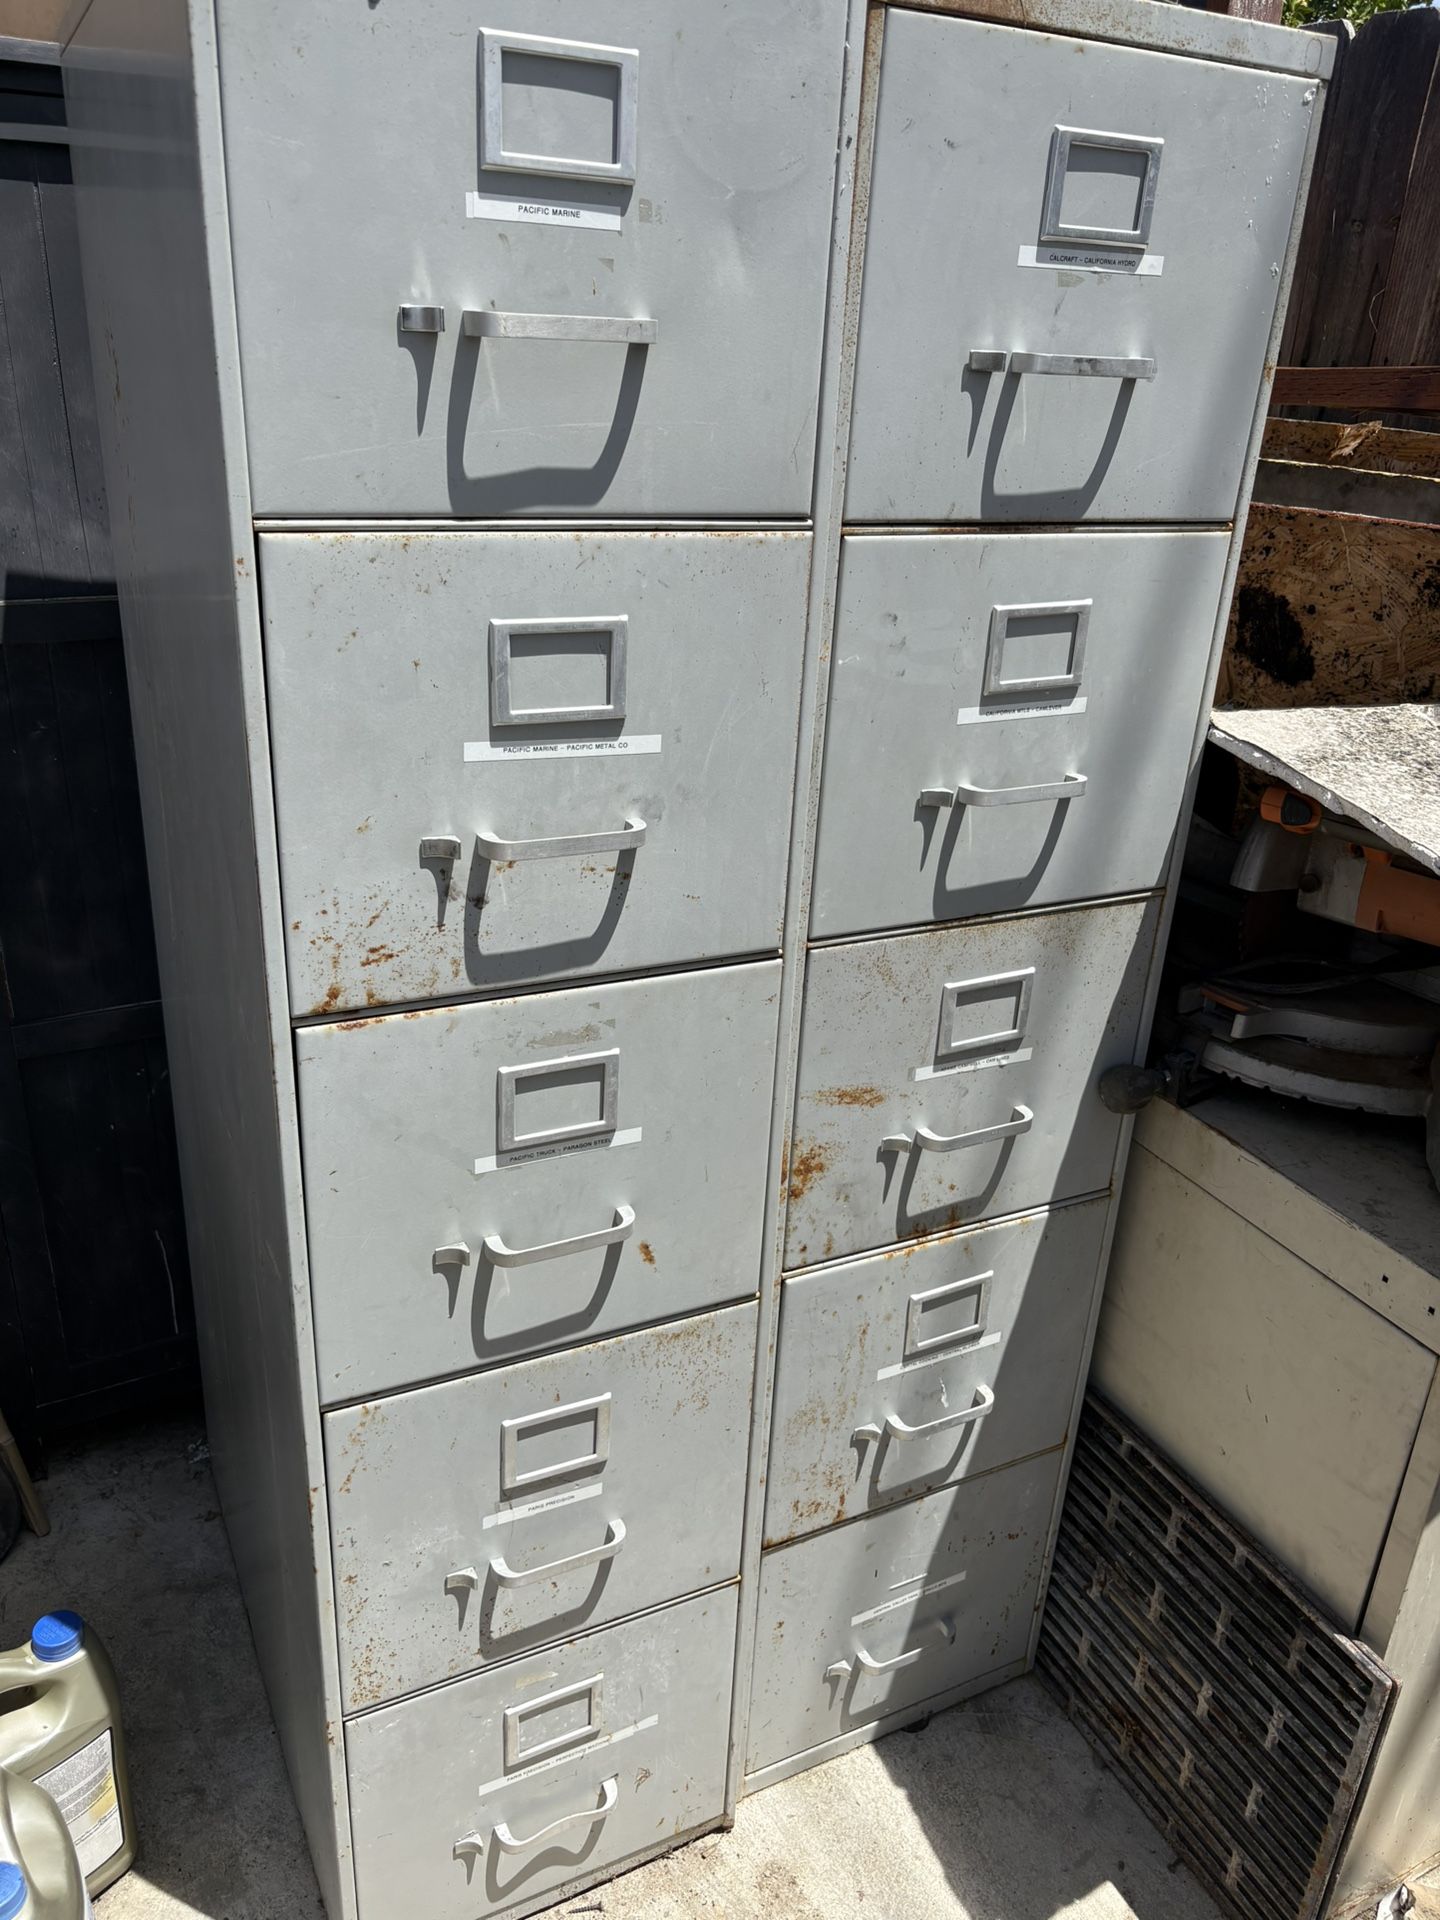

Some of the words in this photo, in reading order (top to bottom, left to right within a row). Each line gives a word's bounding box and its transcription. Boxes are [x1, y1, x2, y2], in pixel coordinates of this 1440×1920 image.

[518, 205, 550, 216] PACIFIC
[551, 208, 581, 219] MARINE
[1049, 254, 1078, 263] CALCRAFT
[1084, 257, 1116, 266] CALIFORNIA
[503, 745, 531, 754] PACIFIC
[532, 744, 559, 752] MARINE
[566, 743, 593, 751] PACIFIC
[594, 742, 616, 750] METAL
[509, 1153, 534, 1163] PACIFIC
[563, 1142, 592, 1152] PARAGON
[593, 1138, 612, 1147] STEEL
